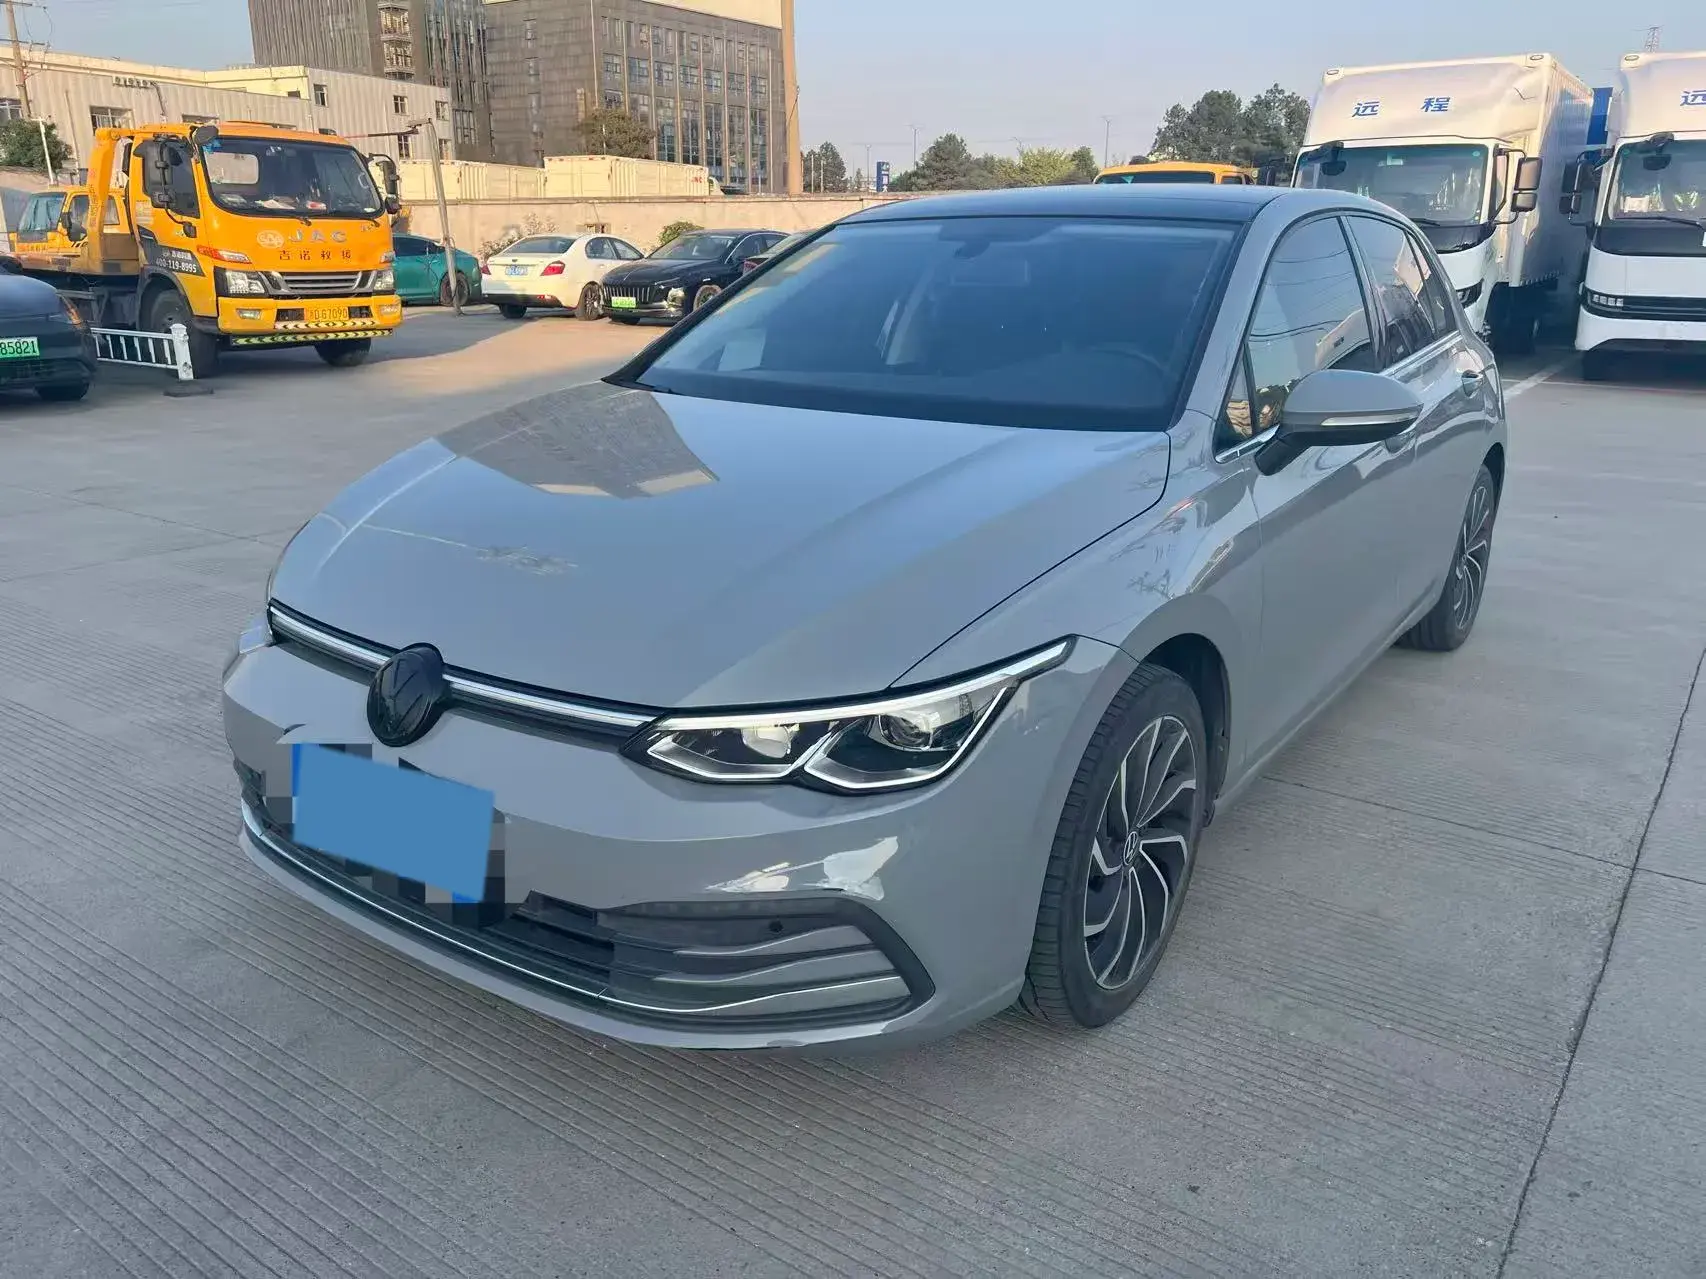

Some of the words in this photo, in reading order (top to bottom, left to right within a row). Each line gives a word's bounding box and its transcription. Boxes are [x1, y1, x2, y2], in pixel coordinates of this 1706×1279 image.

[1352, 97, 1451, 117] 远程
[288, 229, 347, 243] JAC
[0, 340, 37, 355] 85821
